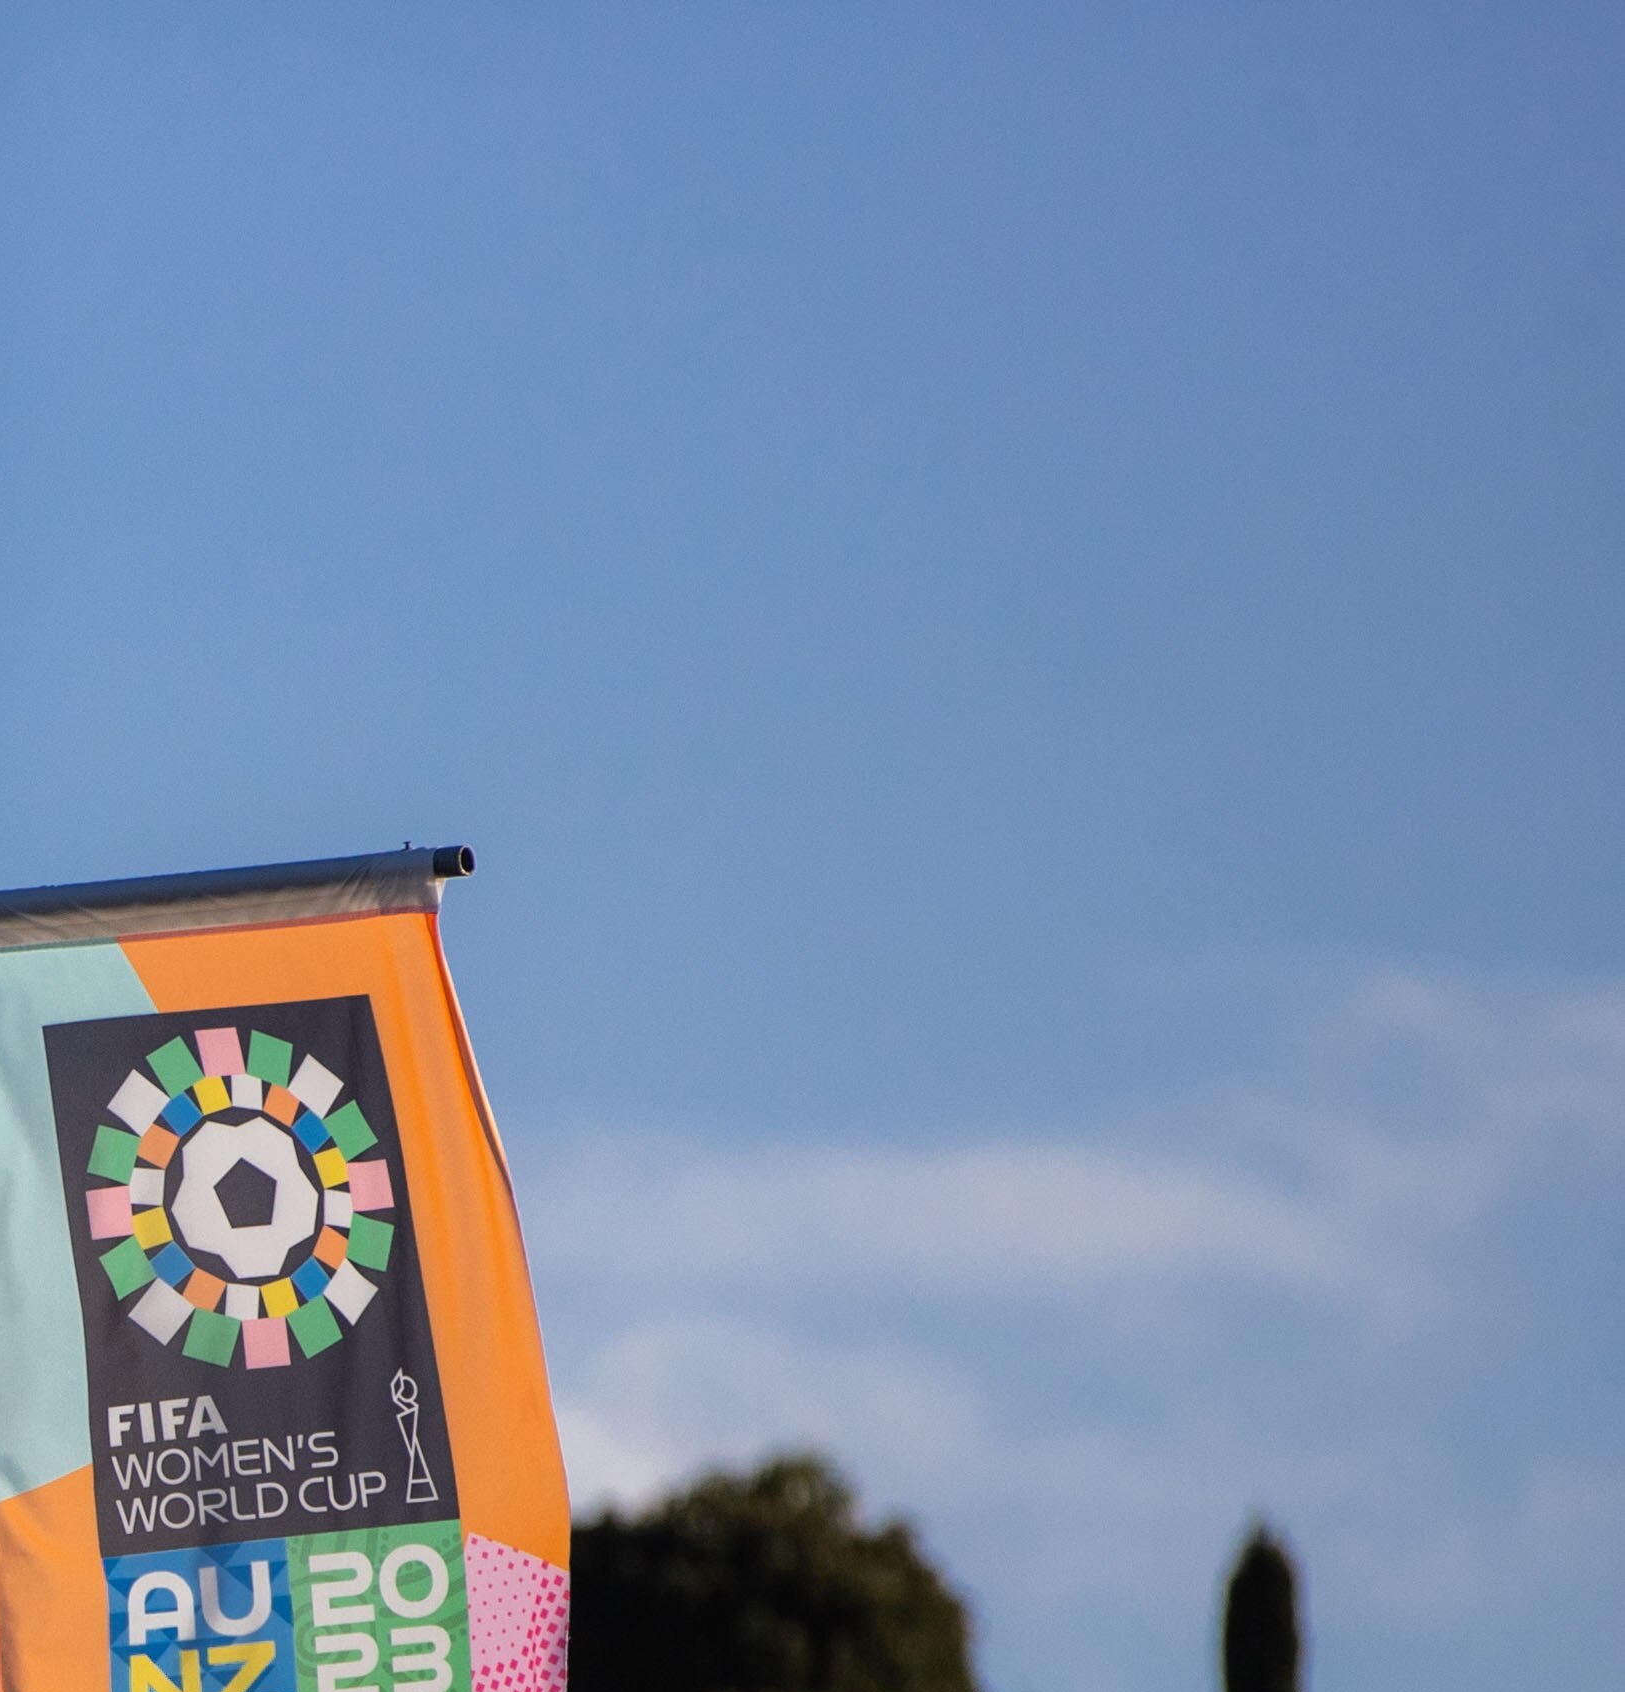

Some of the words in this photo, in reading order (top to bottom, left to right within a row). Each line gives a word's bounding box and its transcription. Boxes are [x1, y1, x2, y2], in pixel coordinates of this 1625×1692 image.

[108, 1395, 228, 1447] FIFA
[112, 1431, 339, 1490] WOMEN'S
[116, 1482, 288, 1534] WORLD
[299, 1471, 386, 1513] CUP
[128, 1560, 272, 1646] AU
[309, 1544, 449, 1627] 20
